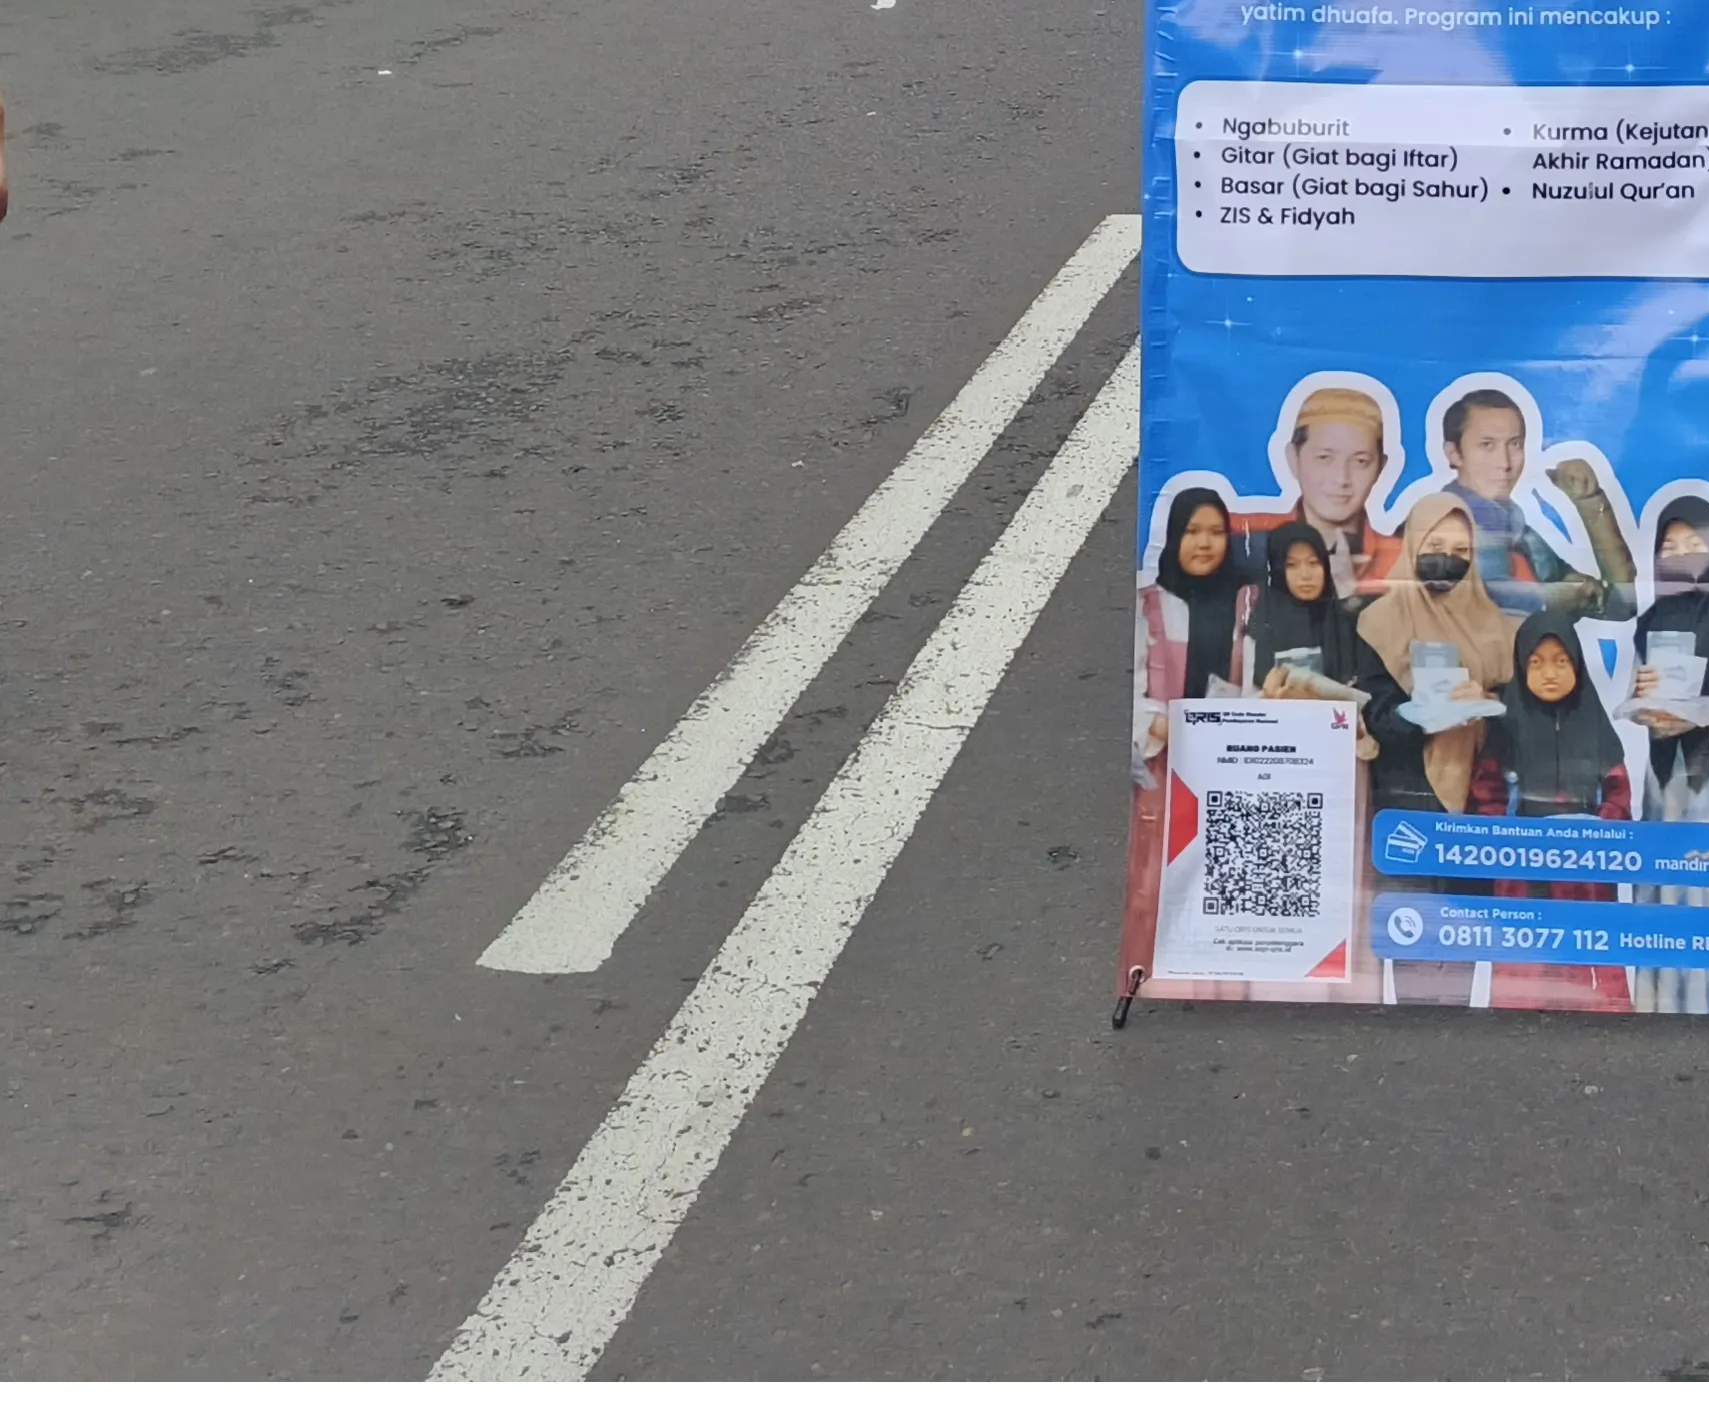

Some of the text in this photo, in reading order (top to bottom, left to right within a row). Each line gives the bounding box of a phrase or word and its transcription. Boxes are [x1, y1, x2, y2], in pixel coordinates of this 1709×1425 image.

[1241, 2, 1305, 25] yatim
[1311, 5, 1398, 25] dhuafa.
[1405, 8, 1502, 31] Program
[1508, 7, 1533, 25] ini
[1539, 7, 1660, 30] mencakup
[1223, 118, 1350, 140] Ngabuburit
[1533, 118, 1708, 146] Kurma (Kejutan
[1221, 143, 1458, 172] Gitar (Giat bagi Iftar)
[1532, 152, 1590, 170] Akhir
[1221, 173, 1488, 203] Basar (Giat bagi Sahur)
[1620, 182, 1695, 202] Qur'an
[1220, 207, 1355, 230] ZIS & Fidyah
[1261, 745, 1297, 753] PASIEN
[1435, 822, 1489, 835] Kirimkan
[1492, 825, 1543, 837] Bantuan
[1546, 828, 1579, 839] Anda
[1582, 829, 1626, 840] Melalui
[1435, 843, 1642, 871] 1420019624120
[1440, 906, 1488, 919] Contact
[1492, 908, 1534, 921] Person
[1439, 925, 1492, 947] 0811
[1502, 928, 1565, 950] 3077
[1573, 929, 1609, 951] 112
[1620, 933, 1686, 950] Hotline
